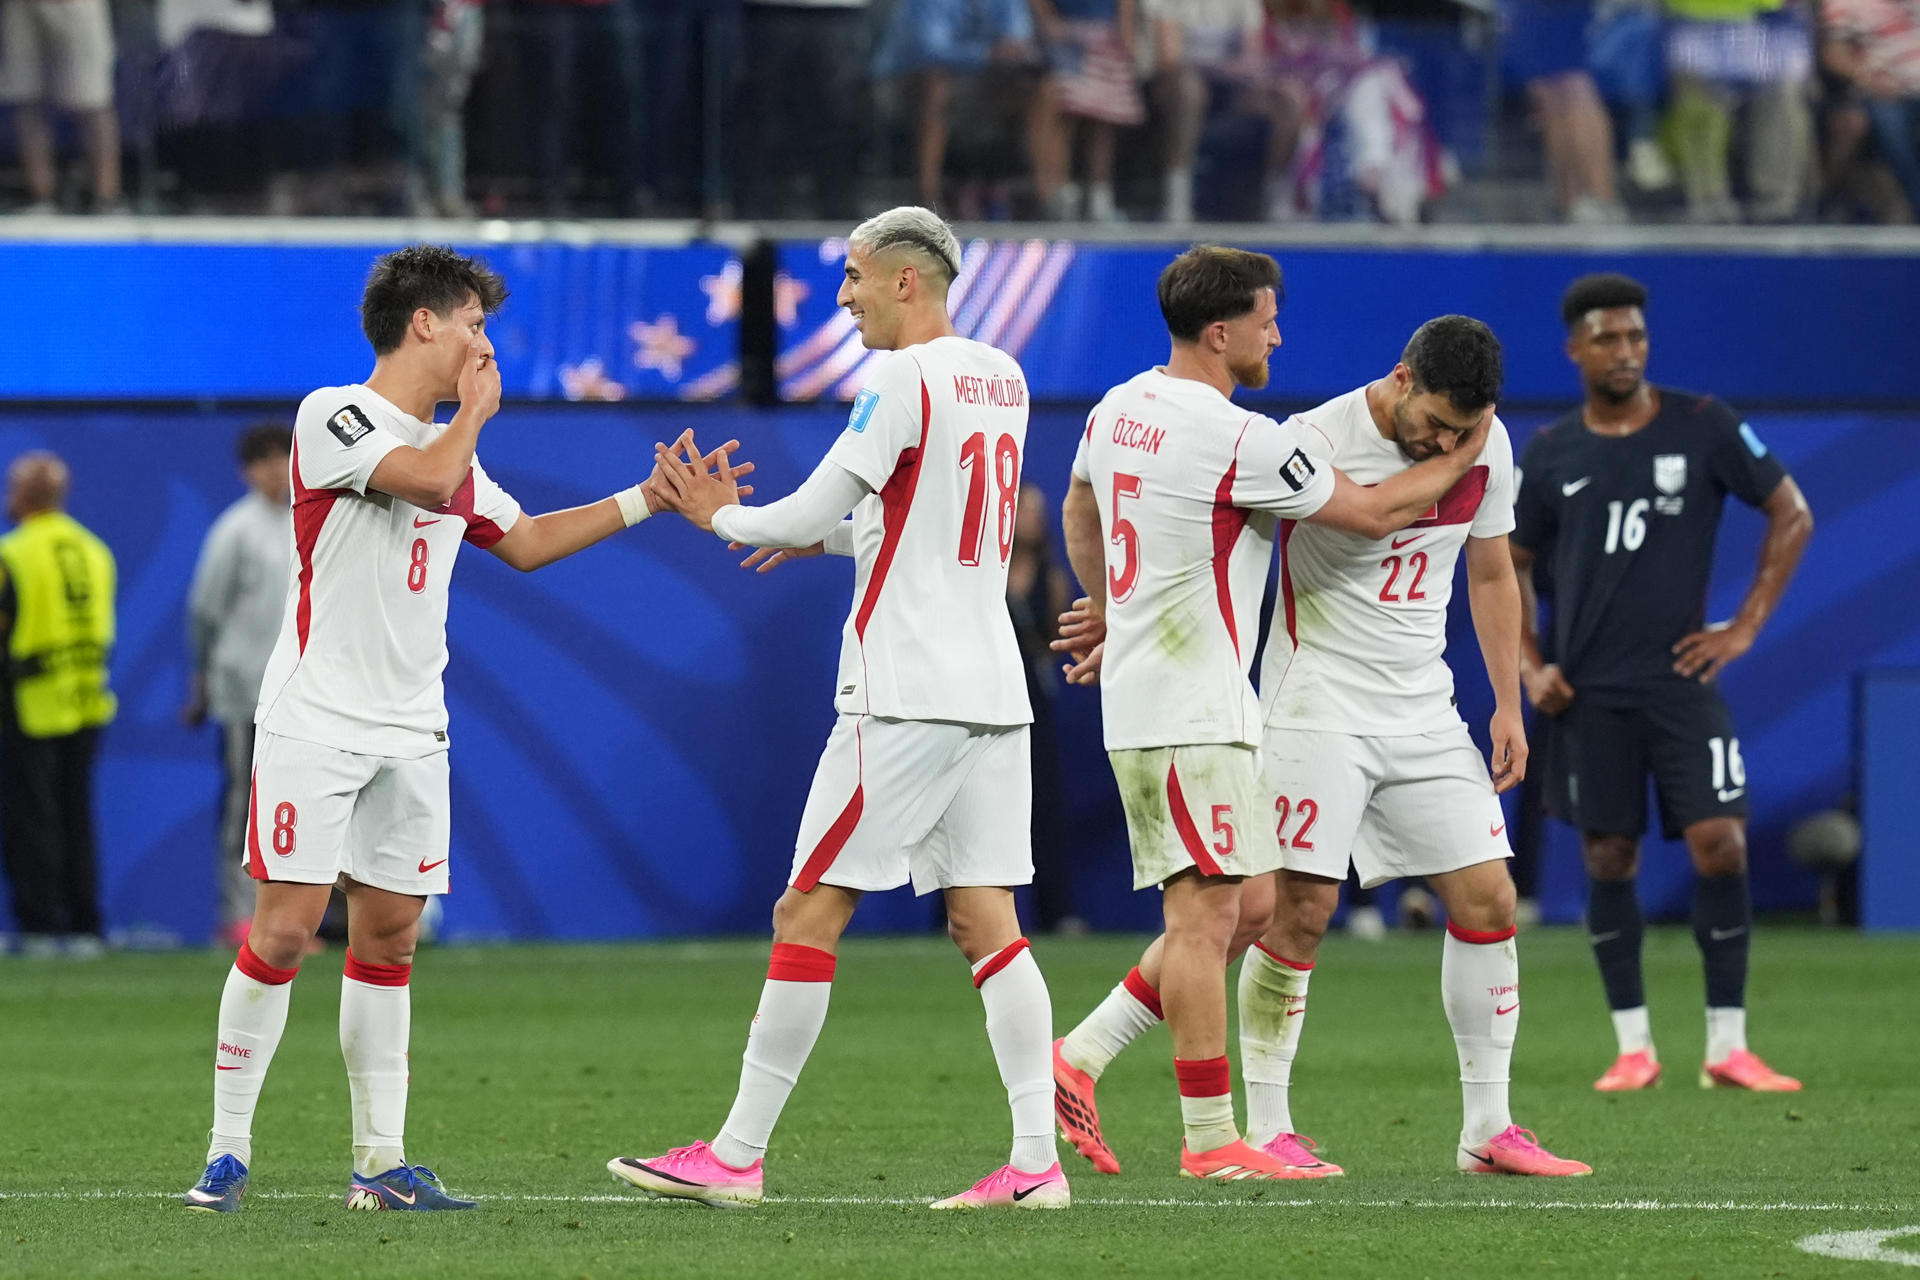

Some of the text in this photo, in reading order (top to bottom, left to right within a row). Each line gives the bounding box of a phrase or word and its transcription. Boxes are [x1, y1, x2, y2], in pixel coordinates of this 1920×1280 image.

[953, 374, 1025, 408] MERT MÜLDÜR
[1113, 412, 1166, 455] ÖZCAN
[958, 431, 1018, 569] 18
[1604, 497, 1650, 554] 16
[407, 537, 430, 594] 8
[1109, 471, 1143, 604] 5
[1379, 551, 1429, 603] 22
[1708, 737, 1746, 791] 16
[273, 801, 298, 858] 8
[1211, 804, 1236, 857] 5
[1275, 795, 1319, 852] 22
